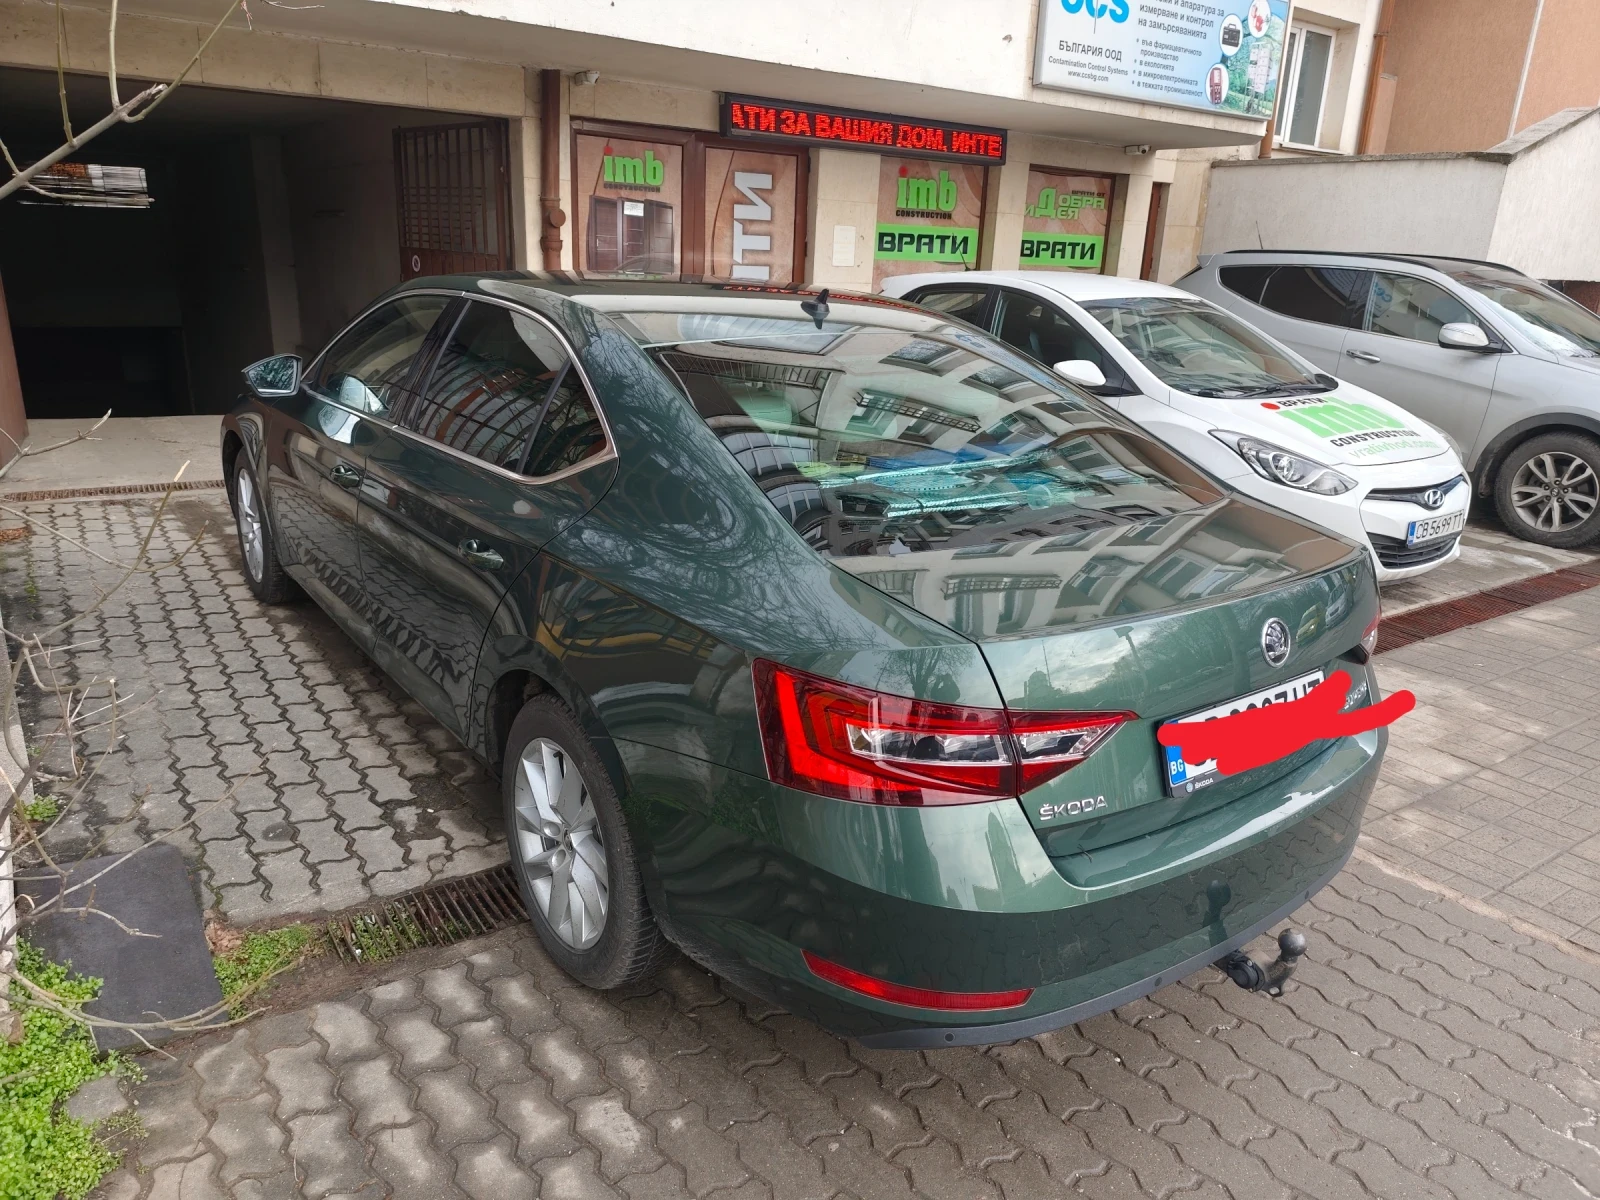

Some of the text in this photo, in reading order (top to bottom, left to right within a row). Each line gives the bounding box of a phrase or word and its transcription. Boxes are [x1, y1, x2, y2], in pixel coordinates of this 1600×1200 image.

[1139, 4, 1179, 20] измерване
[1185, 15, 1214, 28] контрол
[1216, 8, 1225, 17] за
[1138, 18, 1207, 39] на замърсяванията
[1058, 39, 1123, 62] БЪЛГАРИЯ ООД
[1141, 39, 1153, 47] във
[1048, 55, 1129, 76] Contamination Control Systems
[1140, 49, 1179, 62] производство
[1067, 70, 1109, 82] www.ccsbg.com
[1142, 81, 1163, 91] тежката
[1164, 85, 1204, 97] промишленост
[780, 110, 812, 136] ЗА
[815, 114, 893, 145] ВАШИЯ
[896, 124, 947, 152] ДОМ,
[604, 146, 664, 186] imb
[896, 165, 958, 212] imb
[895, 209, 953, 220] CONSTRUCTION
[877, 231, 969, 255] ВРАТИ
[1020, 239, 1096, 261] ВРАТИ
[1276, 397, 1329, 408] ВРАТИ
[1262, 396, 1406, 439] imb
[1329, 429, 1422, 448] CONSTRUCTION
[1170, 759, 1184, 775] BG
[1194, 777, 1214, 790] ŠKODA
[1039, 795, 1108, 821] ŠKODA
